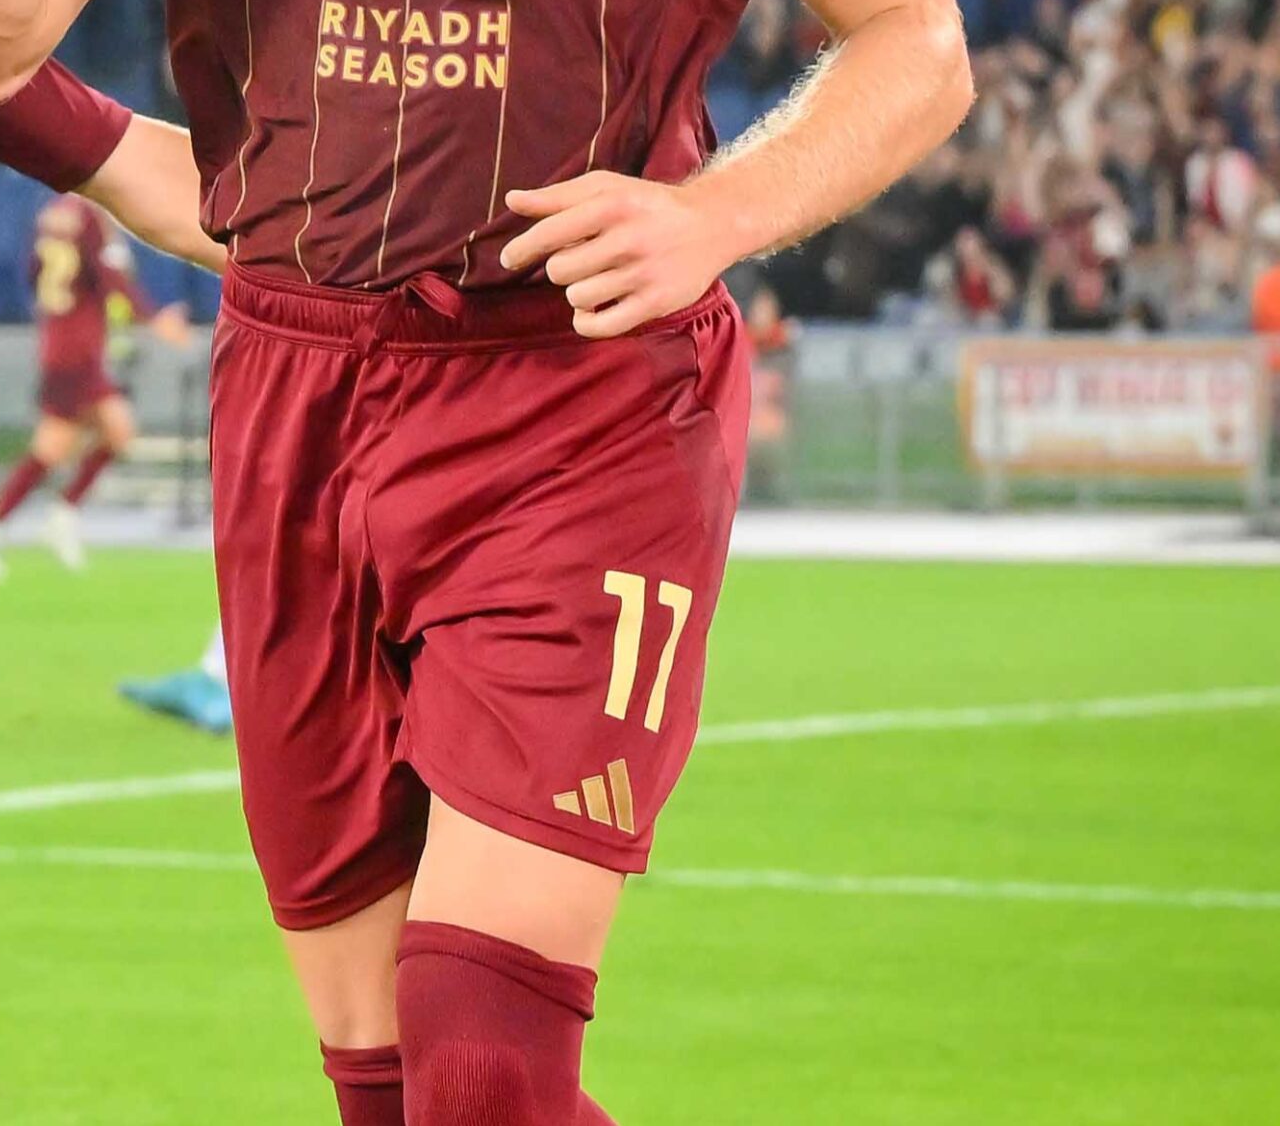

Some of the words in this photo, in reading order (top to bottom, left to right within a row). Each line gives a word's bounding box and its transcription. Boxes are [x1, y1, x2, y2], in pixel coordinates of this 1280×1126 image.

[321, 0, 509, 46] RIYADH
[317, 43, 507, 89] SEASON
[603, 570, 693, 734] 11
